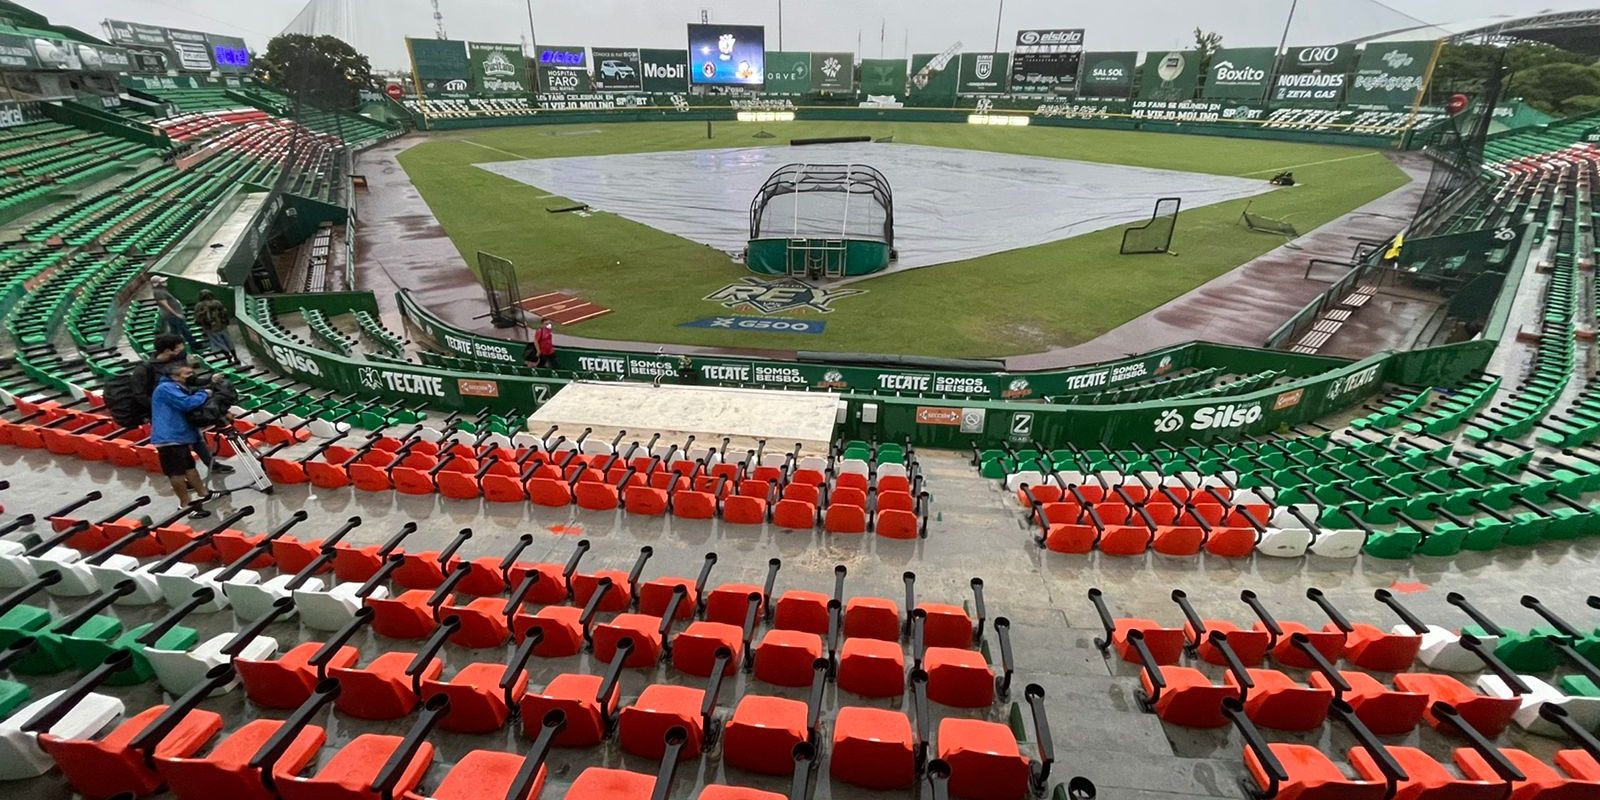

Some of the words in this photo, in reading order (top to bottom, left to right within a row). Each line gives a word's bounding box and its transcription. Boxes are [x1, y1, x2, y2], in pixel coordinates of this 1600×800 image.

[644, 63, 684, 78] Mobil
[767, 72, 796, 80] ORVE
[1217, 66, 1264, 81] Boxito
[447, 82, 464, 91] LTH
[549, 77, 578, 87] FARO
[1278, 74, 1344, 87] NOVEDADES
[1286, 90, 1311, 98] ZETA
[1314, 90, 1336, 98] GAS
[580, 101, 615, 109] MOLINO
[445, 334, 473, 355] TECATE
[475, 343, 508, 354] SOMOS
[272, 345, 320, 376] Silso
[476, 350, 516, 362] BEISBOL
[578, 356, 625, 373] TECATE
[630, 360, 673, 370] SOMOS
[756, 366, 800, 376] SOMOS
[1112, 362, 1145, 376] SOMOS
[630, 367, 680, 378] BEISBOL
[701, 364, 750, 381] TECATE
[756, 374, 808, 384] BEISBOL
[1111, 368, 1148, 383] BEISBOL
[1344, 363, 1381, 394] TECATE
[381, 371, 445, 397] TECATE
[877, 374, 931, 391] TECATE
[936, 376, 984, 386] SOMOS
[1066, 370, 1110, 390] TECATE
[935, 384, 991, 394] BEISBOL
[1013, 414, 1031, 434] Z
[1191, 405, 1262, 430] Silso
